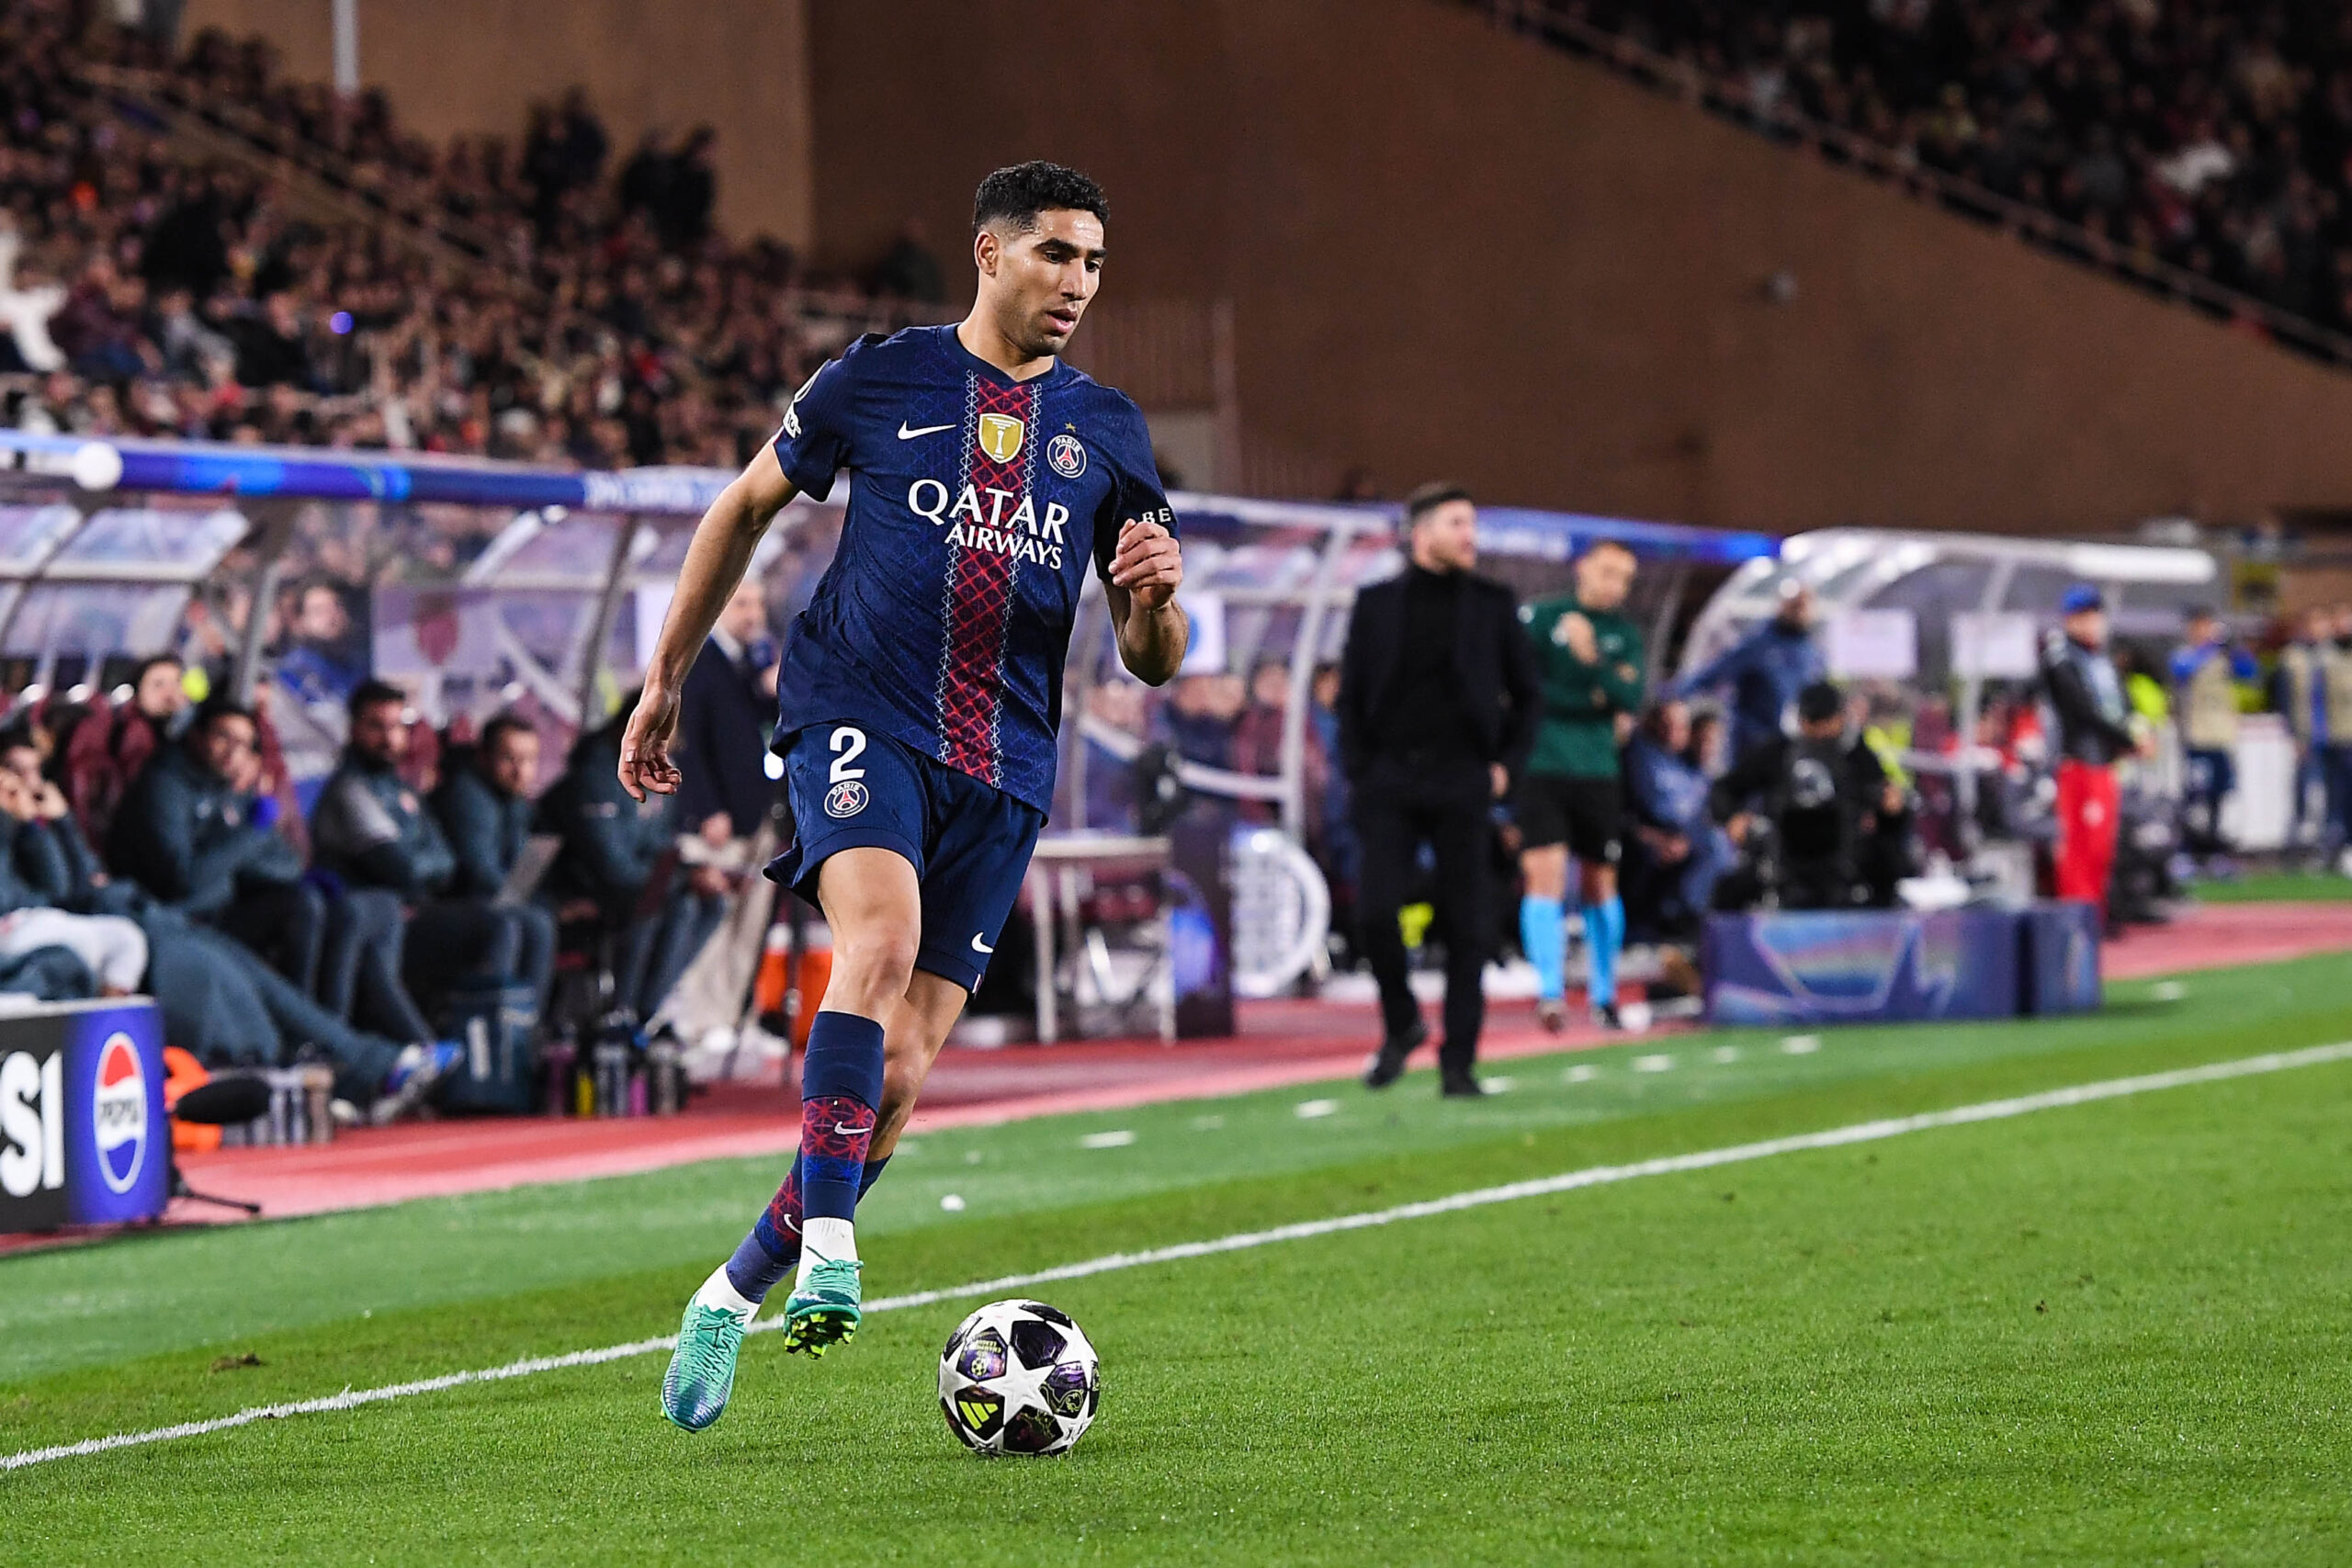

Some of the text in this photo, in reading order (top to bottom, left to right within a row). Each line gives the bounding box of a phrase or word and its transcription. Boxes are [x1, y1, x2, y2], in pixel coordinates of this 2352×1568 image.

[908, 479, 1069, 545] QATAR
[944, 522, 1063, 570] AIRWAYS
[829, 726, 866, 784] 2
[831, 783, 861, 796] PARIS
[0, 1049, 64, 1198] SI
